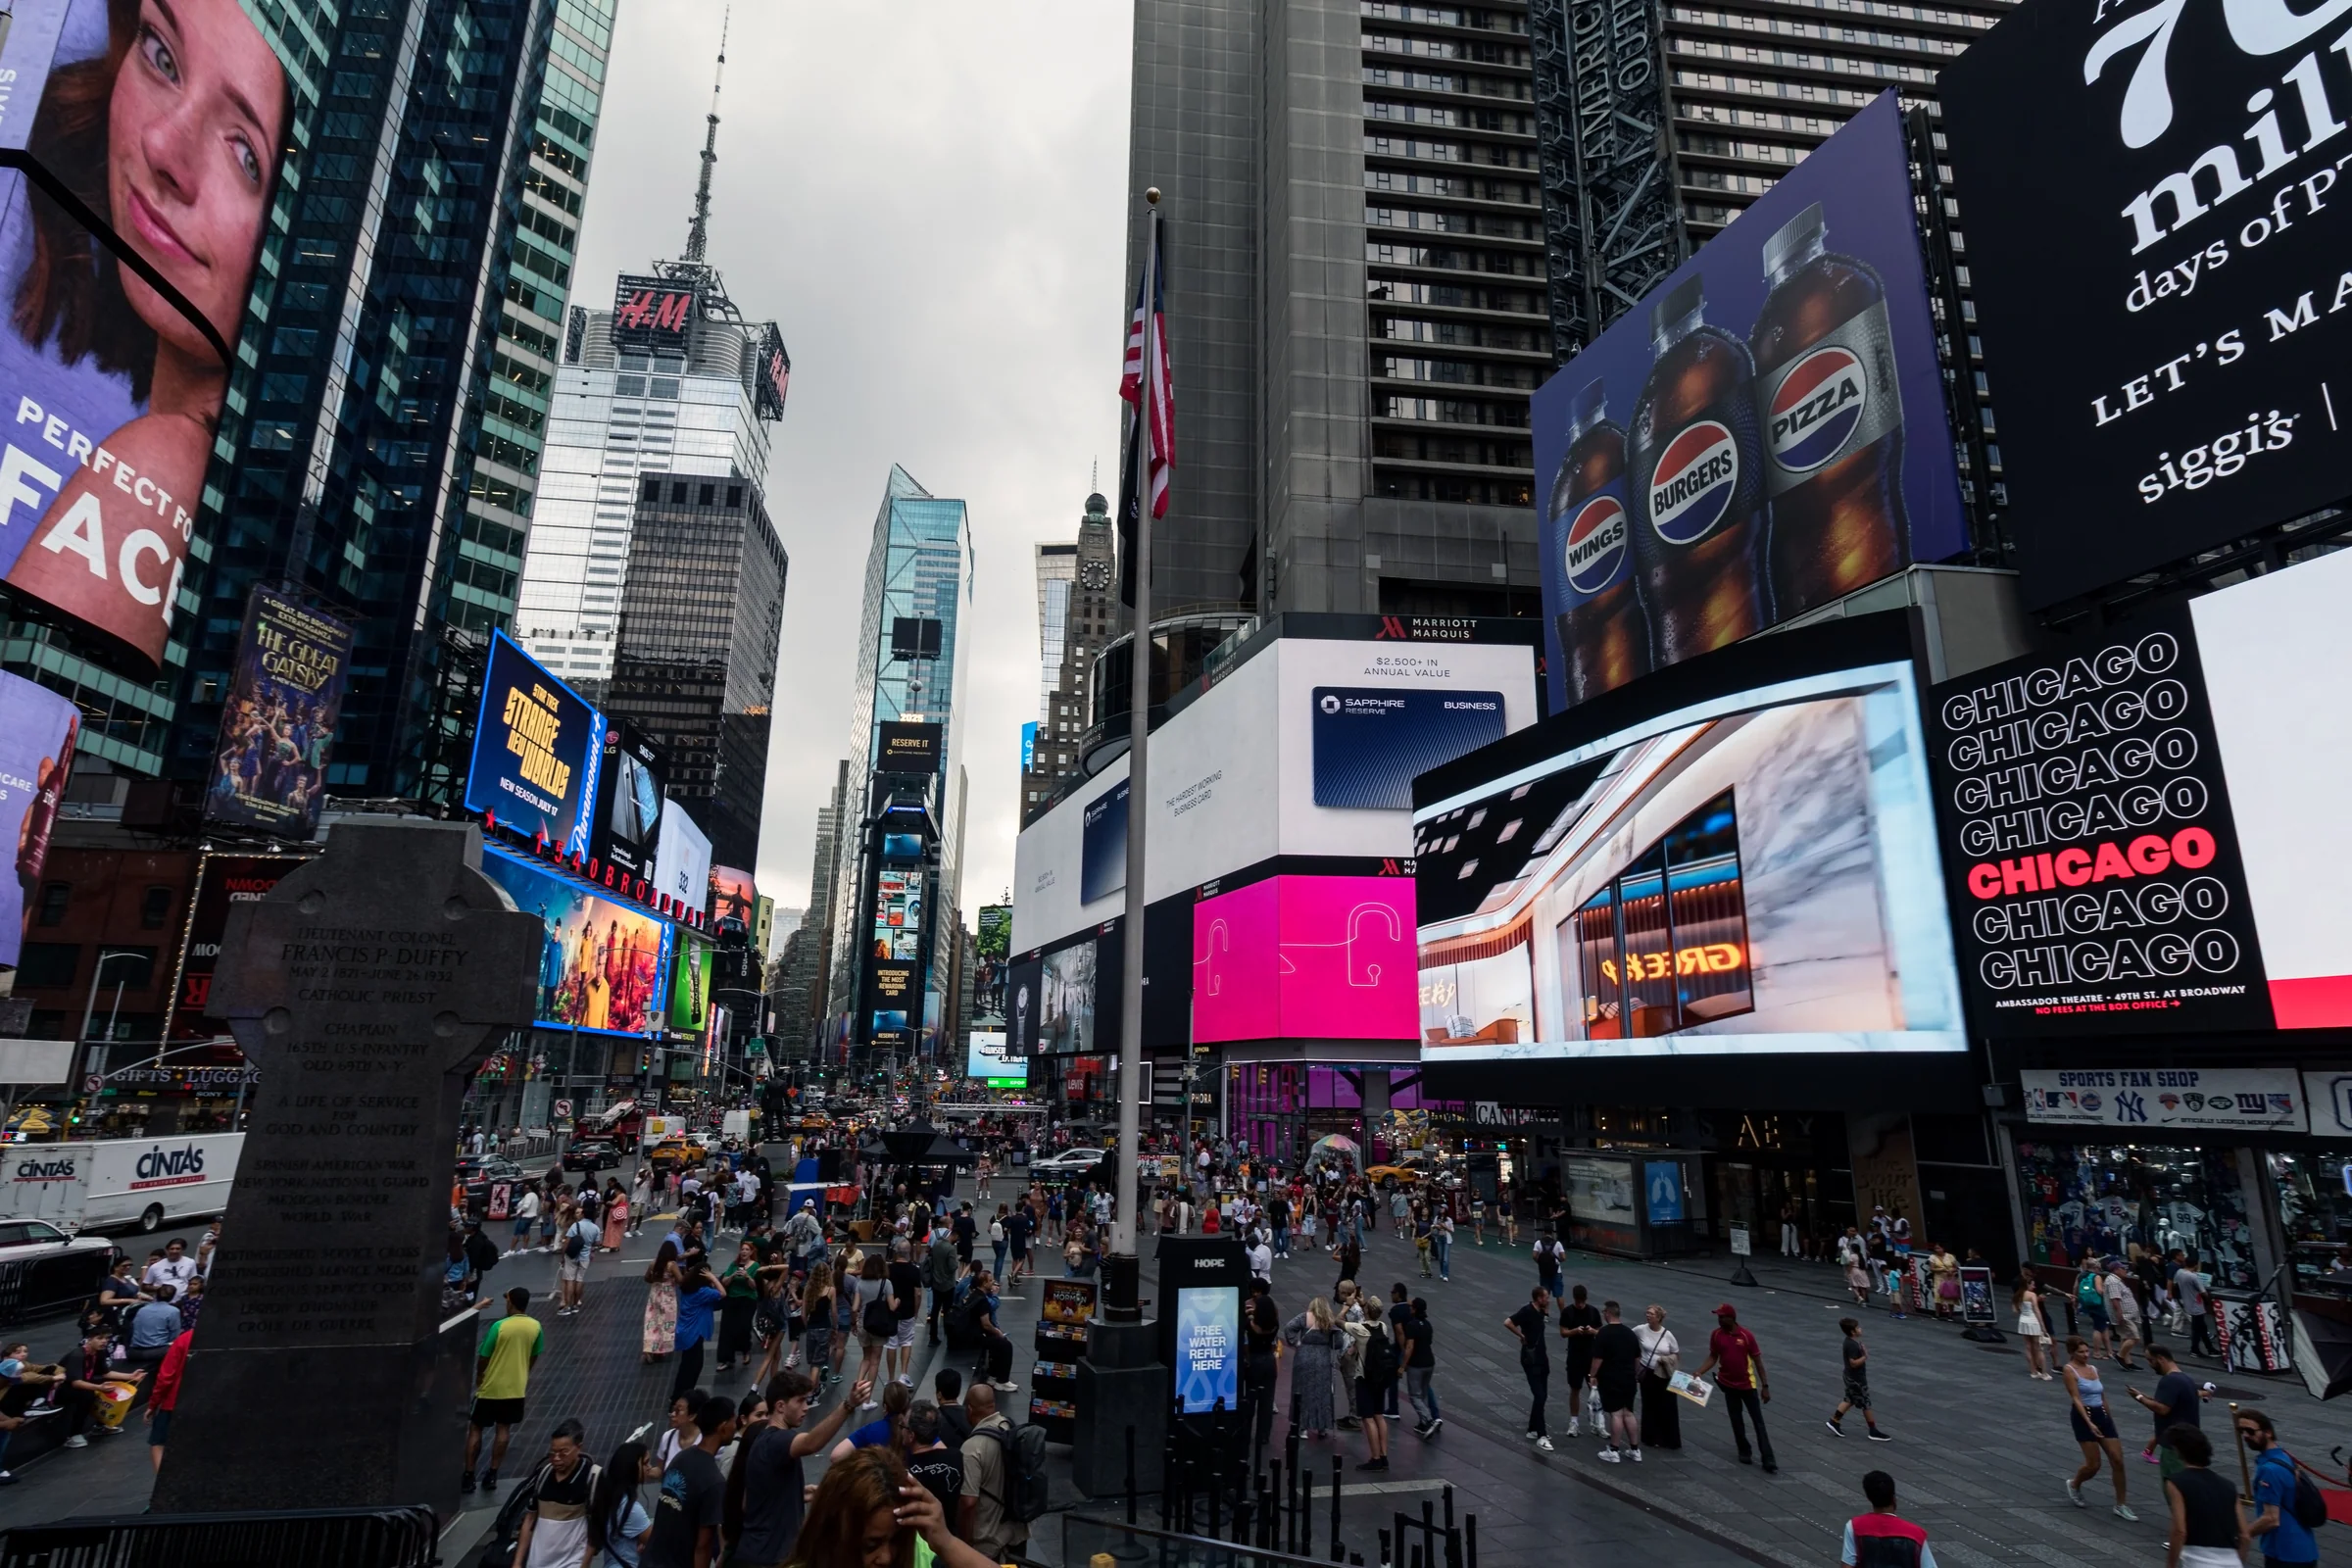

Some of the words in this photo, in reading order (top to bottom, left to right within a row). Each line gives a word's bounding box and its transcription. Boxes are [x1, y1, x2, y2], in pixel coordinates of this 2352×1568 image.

[2126, 239, 2230, 313] days
[2240, 185, 2294, 248] of
[616, 290, 692, 333] H&M
[2090, 328, 2245, 427] LET'S
[1771, 377, 1860, 445] PIZZA
[2137, 410, 2294, 505] siggi's
[16, 395, 172, 516] PERFECT
[172, 505, 193, 543] FO
[1652, 447, 1733, 515] BURGERS
[1568, 520, 1625, 567] WINGS
[1412, 617, 1478, 628] MARRIOTT
[1412, 628, 1471, 639] MARQUIS
[288, 640, 339, 676] GREAT
[1211, 652, 1237, 674] MARRIOTT
[1427, 658, 1439, 667] IN
[262, 651, 329, 690] GATSBY
[1211, 663, 1235, 685] MARQUIS
[1363, 666, 1410, 677] ANNUAL
[1414, 668, 1450, 678] VALUE
[1941, 632, 2179, 731] CHICAGO
[1345, 698, 1405, 708] SAPPHIRE
[1444, 701, 1496, 710] BUSINESS
[503, 686, 561, 754] STRANGE
[900, 713, 924, 722] 2025
[1948, 678, 2188, 771] CHICAGO
[604, 745, 616, 755] LG
[891, 738, 921, 748] RESERVE
[922, 739, 930, 748] IT
[507, 729, 525, 758] NEW
[519, 747, 571, 801] WORLDS
[1954, 727, 2198, 814] CHICAGO
[500, 776, 514, 794] NEW
[514, 784, 538, 808] SEASON
[537, 794, 551, 813] JULY
[551, 807, 559, 817] 17
[1165, 798, 1176, 809] THE
[1176, 783, 1198, 806] HARDEST
[1198, 769, 1222, 793] WORKING
[1174, 798, 1198, 817] BUSINESS
[1198, 789, 1212, 806] CARD
[1960, 775, 2208, 857] CHICAGO
[1968, 826, 2217, 900] CHICAGO
[604, 863, 706, 931] BROADWAY
[1973, 876, 2229, 945] CHICAGO
[297, 927, 383, 942] LIEUTENANT
[388, 931, 456, 946] COLONEL
[280, 944, 368, 963] FRANCIS
[396, 947, 469, 966] DUFFY
[1980, 928, 2239, 989] CHICAGO
[289, 966, 317, 978] MAY
[320, 966, 329, 978] 2
[424, 970, 453, 982] 1932
[298, 988, 372, 1003] CATHOLIC
[381, 990, 437, 1004] PRIEST
[1995, 996, 2059, 1008] AMBASSADOR
[2061, 994, 2103, 1004] THEATRE
[2115, 991, 2140, 1002] 49TH
[2144, 990, 2160, 1000] ST.
[2163, 989, 2178, 999] AT
[2180, 985, 2246, 998] BROADWAY
[2035, 1006, 2050, 1015] NO
[2053, 1004, 2074, 1014] FEES
[2075, 1004, 2087, 1013] AT
[2088, 1003, 2107, 1012] THE
[2109, 1002, 2131, 1011] BOX
[2132, 1000, 2169, 1010] OFFICE
[324, 1022, 400, 1036] CHAPLAIN
[303, 1059, 334, 1072] OLD
[114, 1068, 172, 1083] GIFTS
[2059, 1071, 2116, 1087] SPORTS
[2120, 1071, 2153, 1087] FAN
[2157, 1071, 2199, 1087] SHOP
[278, 1096, 288, 1107] A
[295, 1096, 326, 1108] LIFE
[332, 1097, 354, 1108] OF
[359, 1097, 419, 1109] SERVICE
[1191, 1093, 1212, 1104] PHORA
[331, 1109, 357, 1121] FOR
[266, 1123, 307, 1136] GOD
[309, 1124, 340, 1136] AND
[346, 1124, 419, 1136] COUNTRY
[18, 1158, 74, 1177] CINTAS
[136, 1142, 204, 1179] CINTAS
[253, 1160, 309, 1172] SPANISH
[312, 1159, 382, 1171] AMERICAN
[385, 1159, 416, 1170] WAR
[381, 1176, 429, 1188] GUARD
[335, 1194, 389, 1205] BORDER
[280, 1211, 331, 1223] WORLD
[341, 1211, 372, 1223] WAR
[2177, 1212, 2191, 1223] 99
[1194, 1258, 1225, 1268] HOPE
[1194, 1325, 1222, 1336] FREE
[1189, 1336, 1226, 1348] WATER
[1189, 1348, 1226, 1359] REFILL
[1192, 1359, 1222, 1371] HERE
